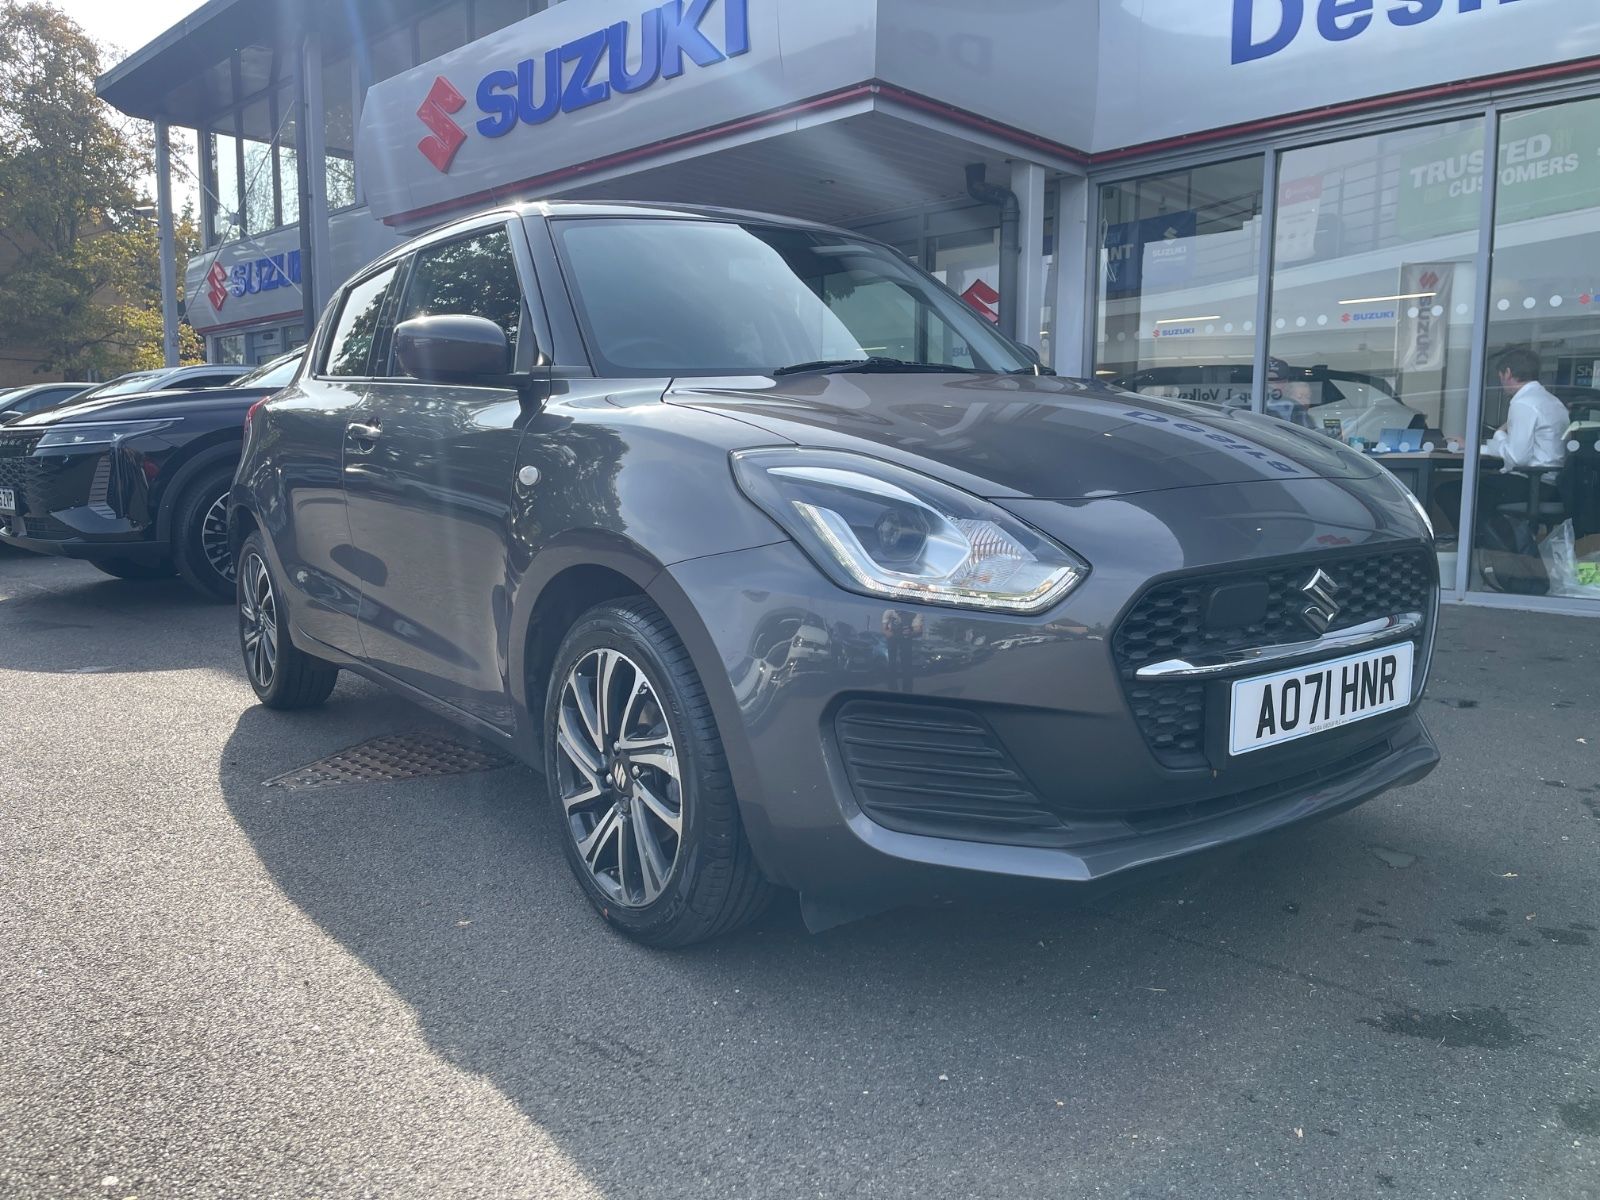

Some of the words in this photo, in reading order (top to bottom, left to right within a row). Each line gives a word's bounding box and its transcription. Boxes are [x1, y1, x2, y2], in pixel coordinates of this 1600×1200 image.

[1230, 0, 1521, 65] Des
[475, 0, 750, 138] SUZUKI
[1449, 153, 1579, 197] CUOMERS
[1162, 327, 1195, 336] SUZUKI
[1353, 311, 1394, 321] SUZUKI
[1340, 654, 1397, 716] HNR
